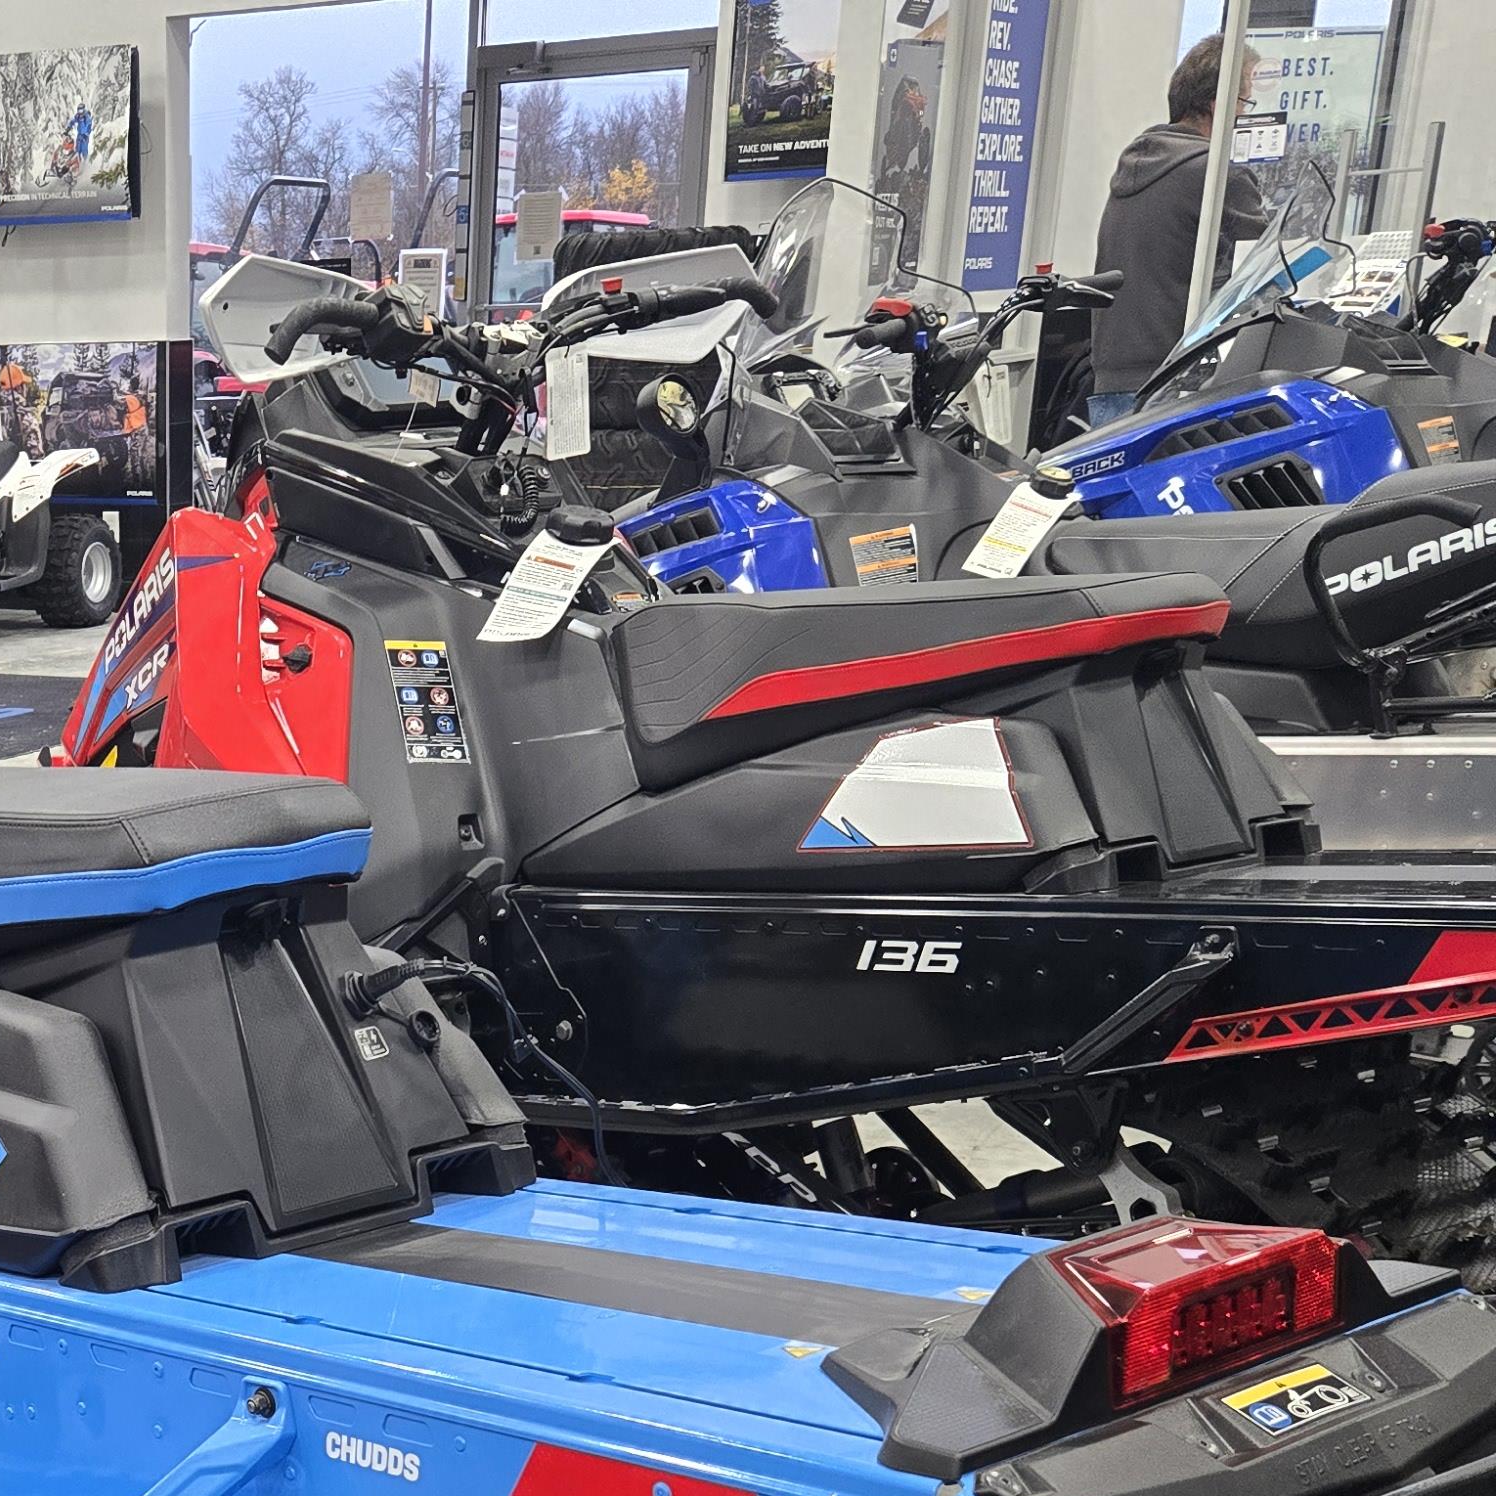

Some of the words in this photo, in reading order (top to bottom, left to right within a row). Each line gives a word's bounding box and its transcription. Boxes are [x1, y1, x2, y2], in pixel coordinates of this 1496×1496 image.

[989, 20, 1011, 51] REV.
[985, 58, 1020, 89] CHASE.
[1281, 57, 1334, 77] BEST.
[981, 95, 1021, 126] GATHER.
[1279, 90, 1327, 110] GIFT.
[738, 144, 759, 154] TAKE
[760, 143, 772, 152] ON
[773, 141, 793, 151] NEW
[794, 139, 830, 150] ADVENT
[976, 133, 1024, 162] EXPLORE.
[974, 170, 1010, 197] THRILL.
[969, 206, 1008, 234] REPEAT.
[965, 257, 993, 270] POLARIS
[104, 546, 174, 674] POLARIS
[124, 642, 169, 710] XCR
[856, 939, 963, 974] 136
[325, 1431, 421, 1482] CHUDDS
